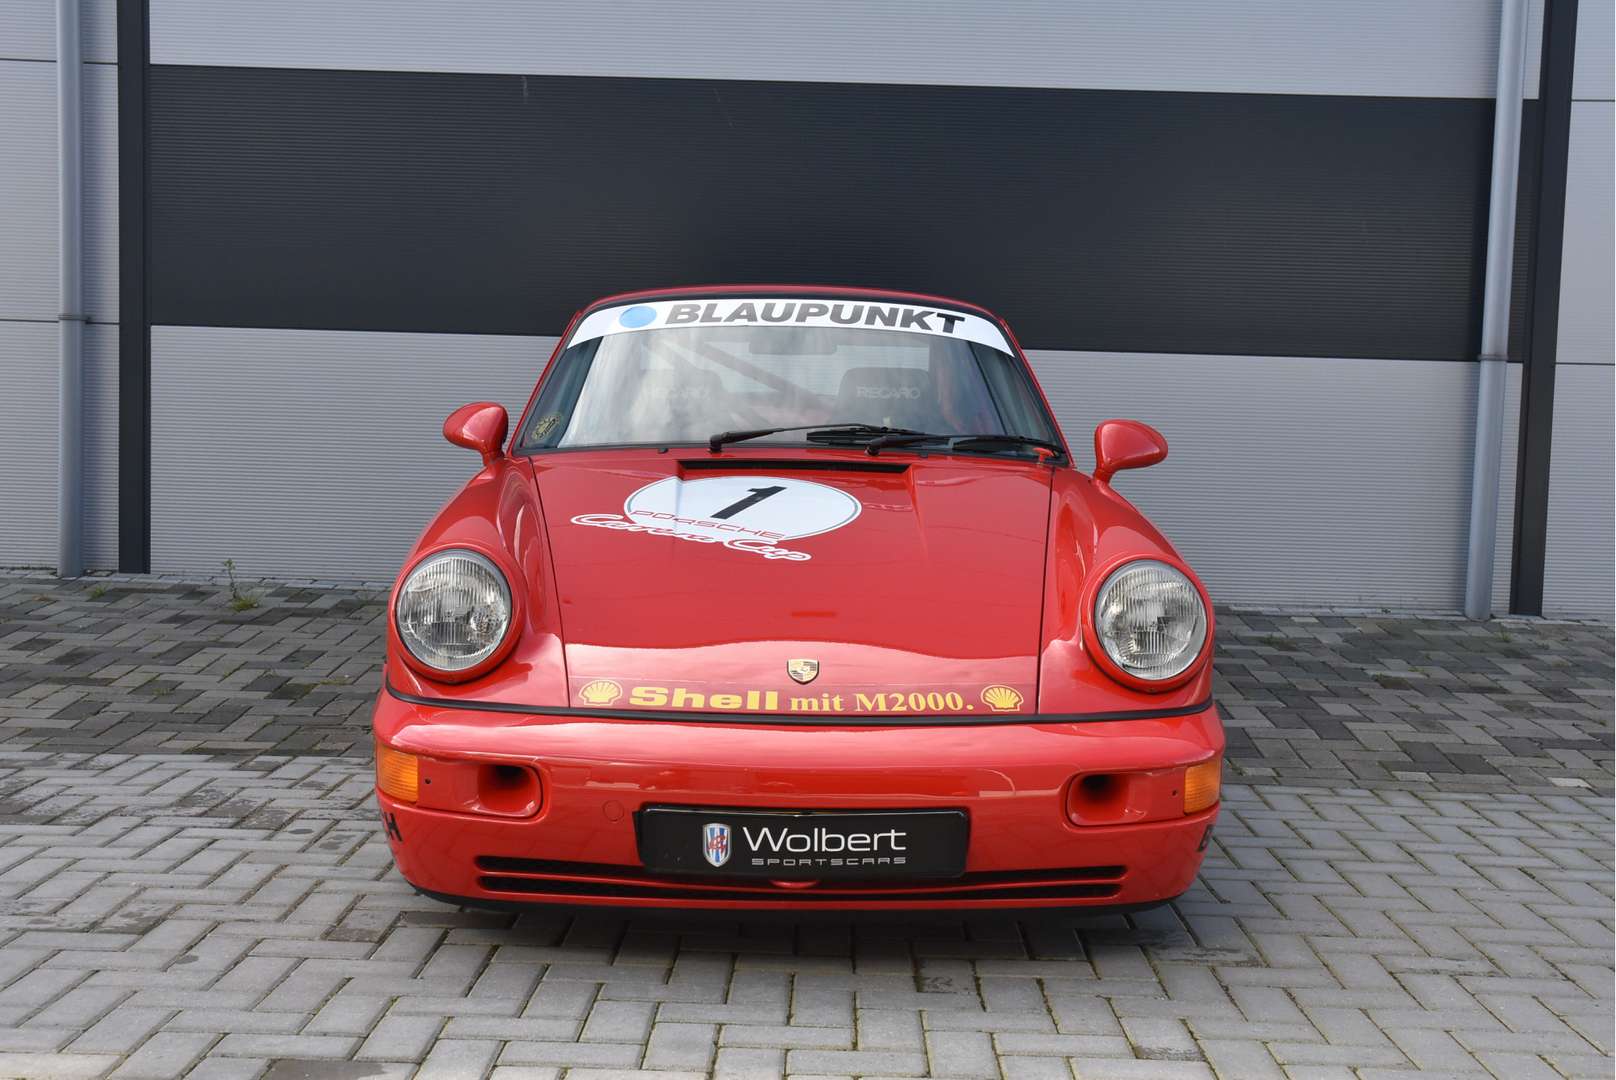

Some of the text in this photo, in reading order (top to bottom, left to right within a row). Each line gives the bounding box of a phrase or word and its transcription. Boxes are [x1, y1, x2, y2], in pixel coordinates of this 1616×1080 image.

[665, 302, 965, 334] BLAUPUNKT
[856, 386, 920, 399] RECARO
[710, 485, 787, 519] 1
[631, 511, 784, 540] PORSCHE
[723, 538, 812, 560] Cup
[629, 686, 973, 712] Shell mit M2000.
[743, 827, 906, 852] Wolbert
[751, 857, 906, 866] SPORTSCARS
